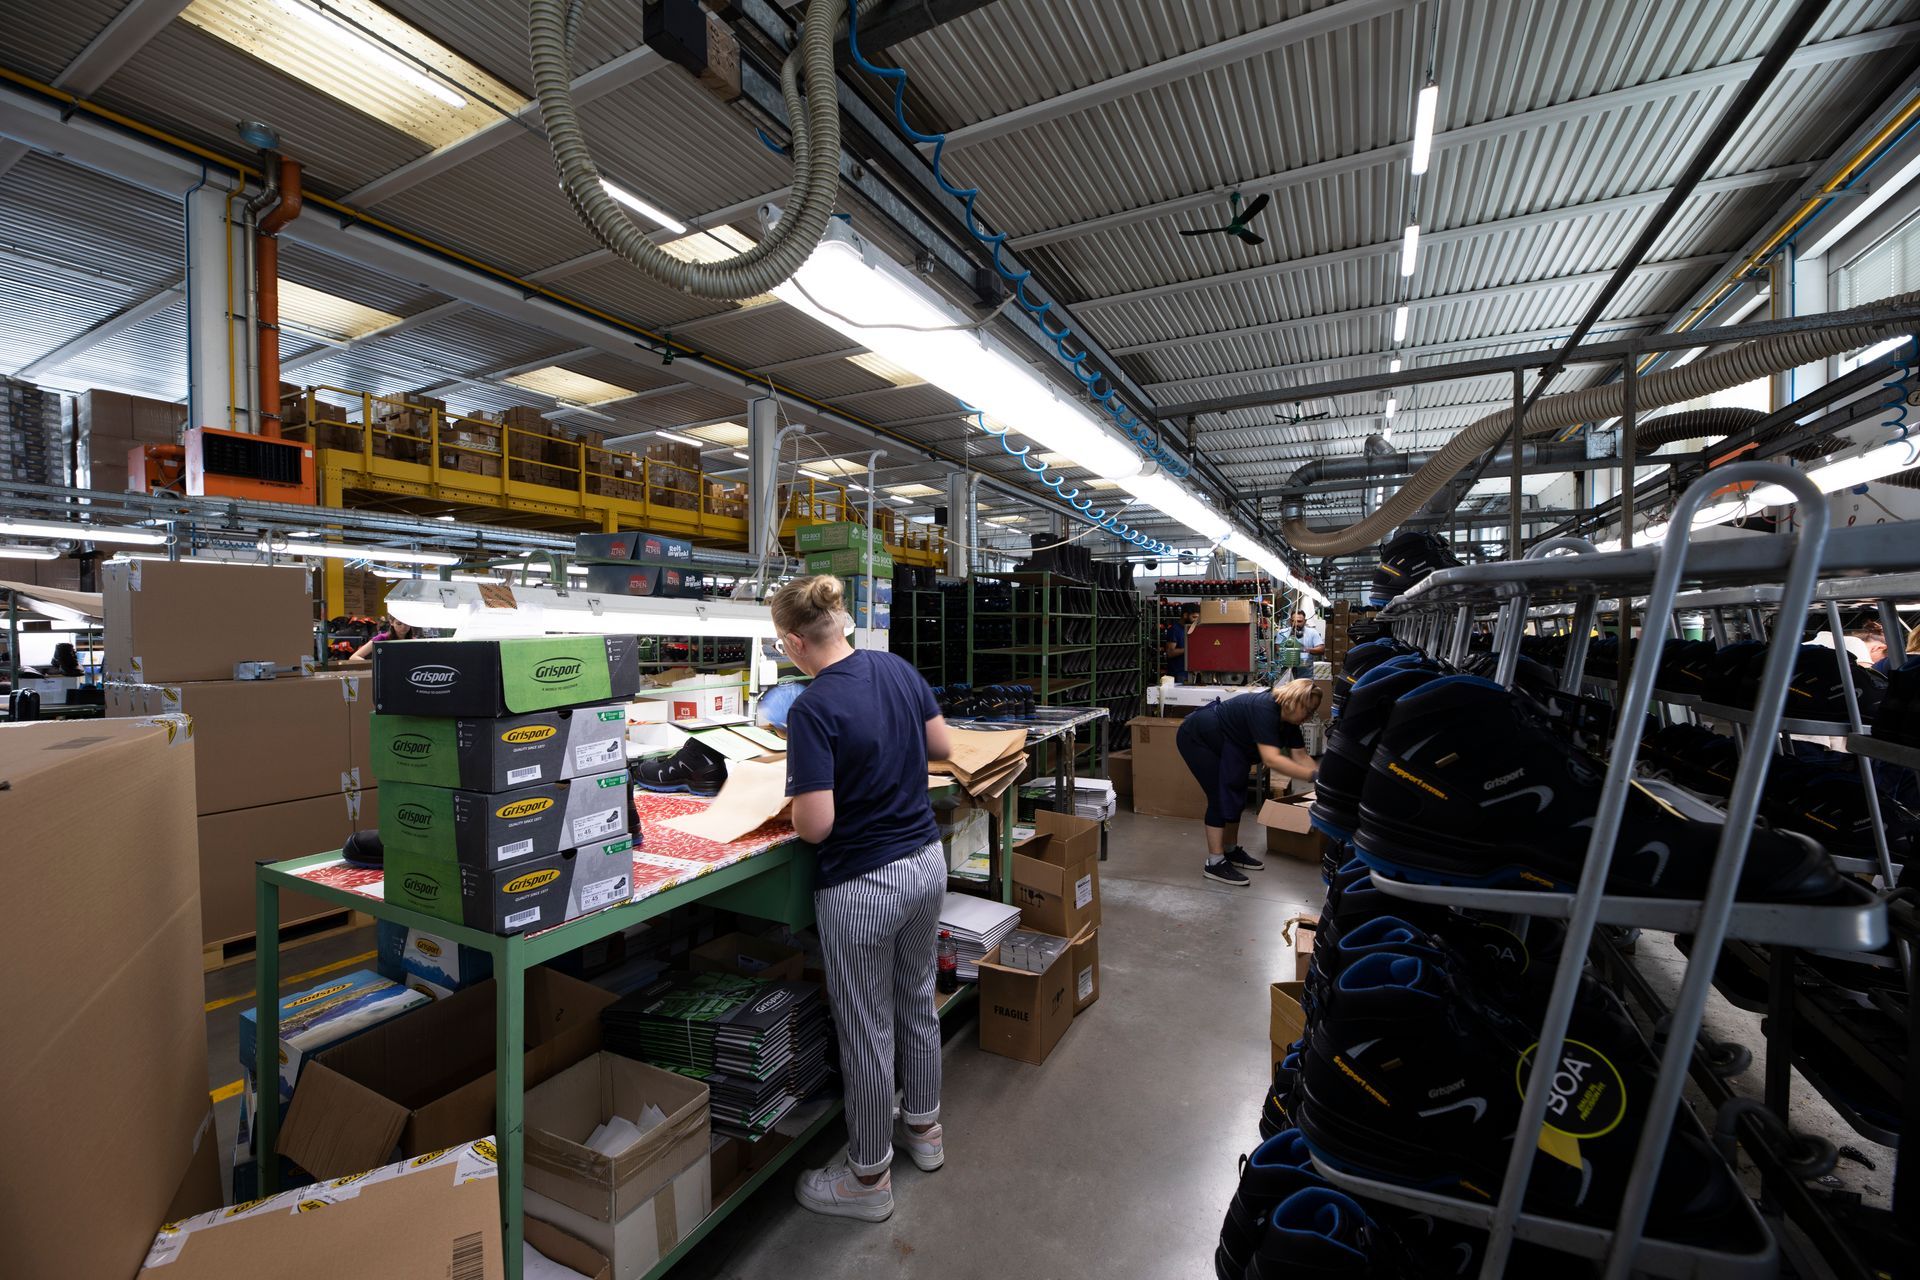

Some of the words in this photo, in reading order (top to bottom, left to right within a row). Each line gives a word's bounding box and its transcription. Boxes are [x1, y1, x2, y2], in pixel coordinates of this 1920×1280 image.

[411, 671, 455, 683] Grisport
[536, 663, 582, 678] Grisport
[507, 727, 552, 741] Grisport
[393, 740, 432, 755] Grisport
[1387, 762, 1423, 788] Support
[1483, 767, 1526, 791] Grisport
[398, 808, 432, 825] Grisport
[502, 800, 548, 817] Grisport
[404, 877, 439, 897] Grisport
[509, 871, 554, 891] Grisport
[417, 941, 440, 955] Grisport
[756, 991, 787, 1012] Grisport
[994, 1005, 1030, 1022] FRAGILE
[1428, 1078, 1466, 1099] Grisport
[1547, 1057, 1592, 1116] BOA
